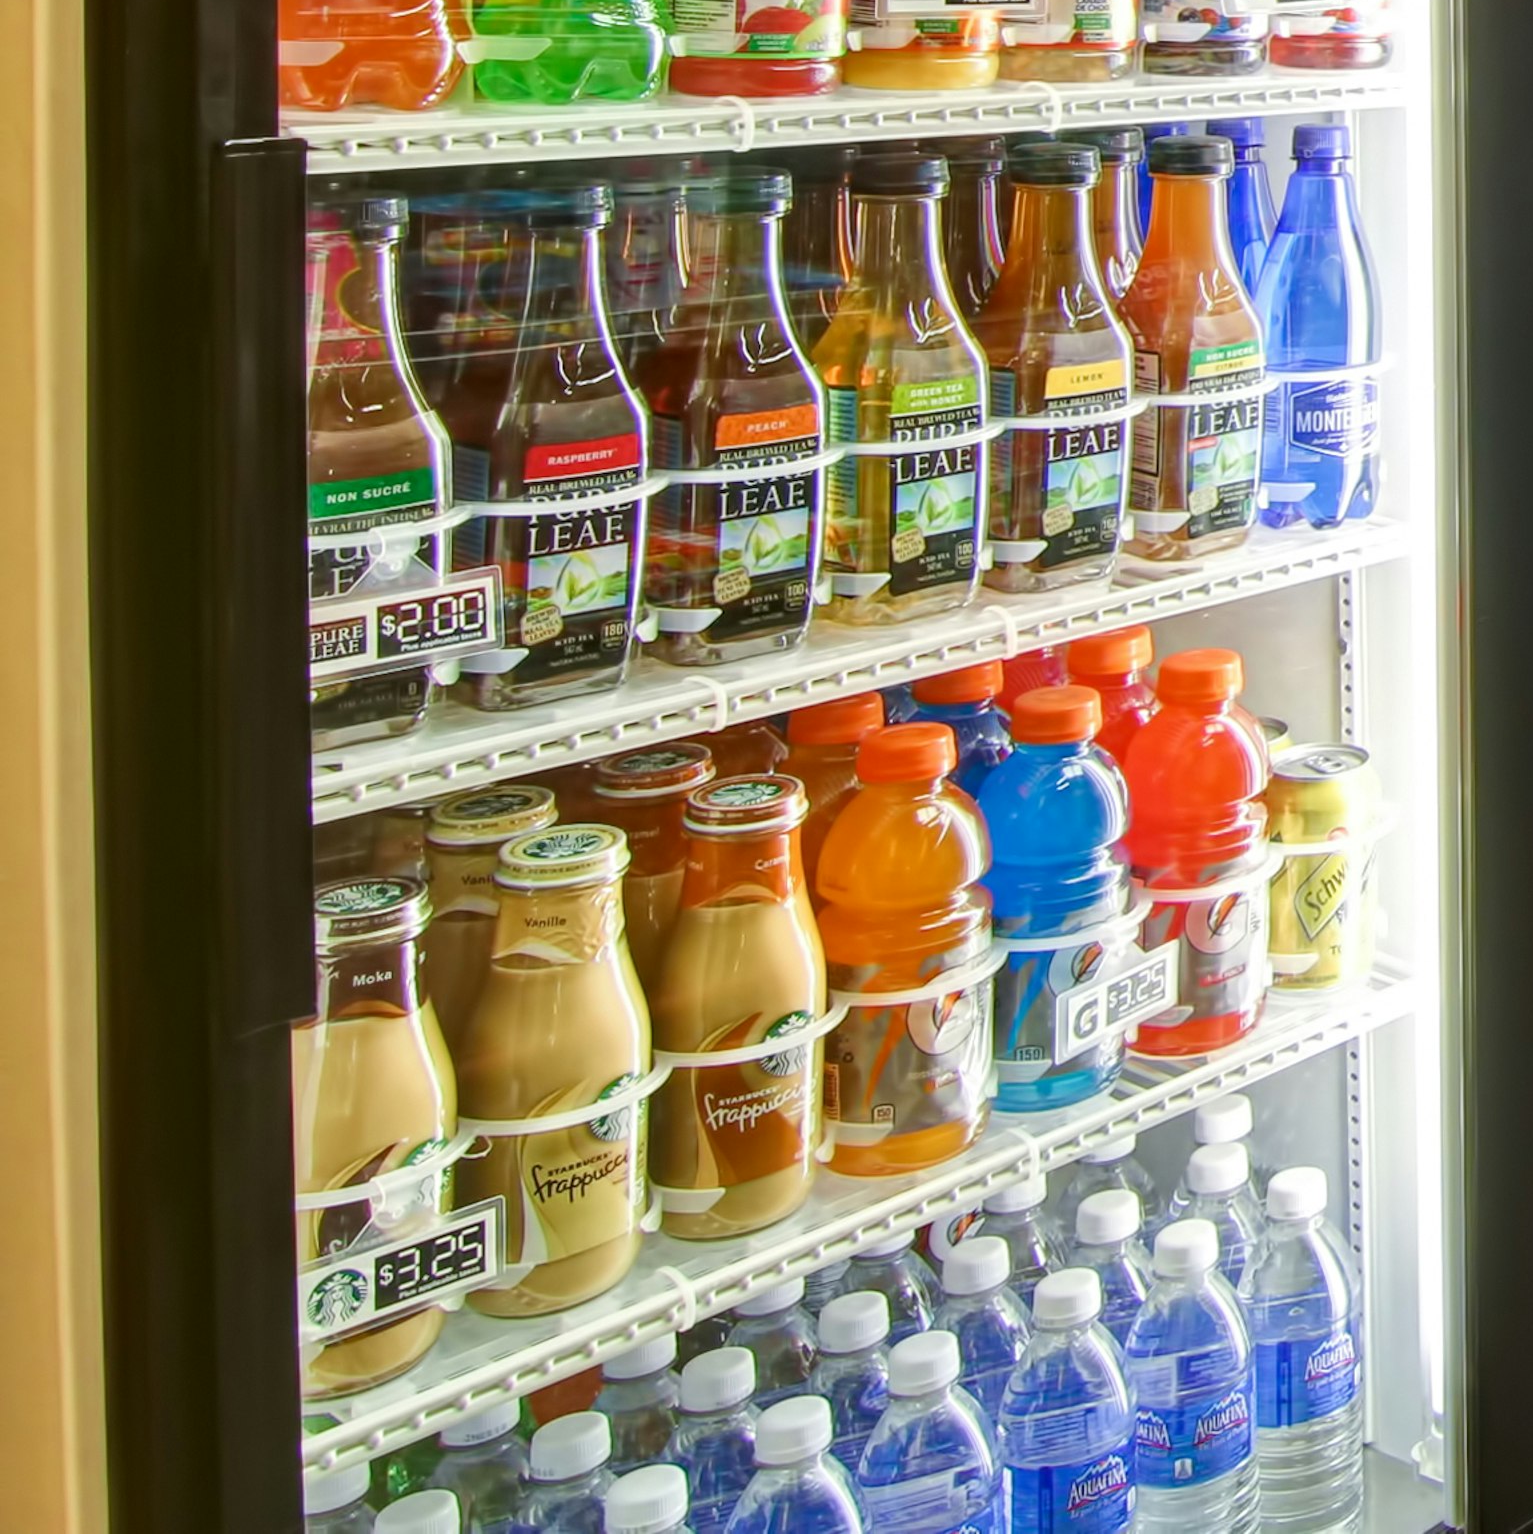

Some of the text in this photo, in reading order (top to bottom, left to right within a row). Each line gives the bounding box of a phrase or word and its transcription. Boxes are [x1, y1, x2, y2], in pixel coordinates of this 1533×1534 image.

[1070, 372, 1104, 384] LEMON
[910, 383, 965, 398] GREEN TEA
[930, 395, 964, 406] HONEY
[747, 421, 787, 433] PEACH
[893, 418, 917, 429] REAL
[1194, 403, 1260, 438] LEAF
[719, 450, 746, 462] REAL
[746, 444, 789, 459] BREWED
[1048, 426, 1119, 462] LEAF
[547, 449, 614, 466] RASPBERRY
[895, 446, 973, 484] LEAF
[326, 481, 412, 504] NON SUCRÉ
[529, 473, 627, 495] REAL BREWED TEA
[719, 481, 805, 521] LEAF
[529, 516, 625, 556] LEAF
[787, 583, 805, 597] 100
[381, 591, 485, 643] $2.00
[310, 625, 365, 646] PURE
[603, 623, 624, 637] 180
[310, 639, 360, 661] LEAF
[524, 916, 567, 929] Vanille
[352, 969, 393, 987] Moka
[1109, 961, 1165, 1012] $3.25
[1073, 996, 1099, 1040] G
[1019, 1048, 1040, 1061] 150
[704, 1079, 813, 1133] frappucci
[531, 1150, 631, 1204] frappucci
[379, 1225, 483, 1291] $3.25
[1305, 1340, 1356, 1380] AQUAFINA
[1194, 1395, 1249, 1445] AQUAFINA
[1067, 1463, 1127, 1510] AQUAFINA
